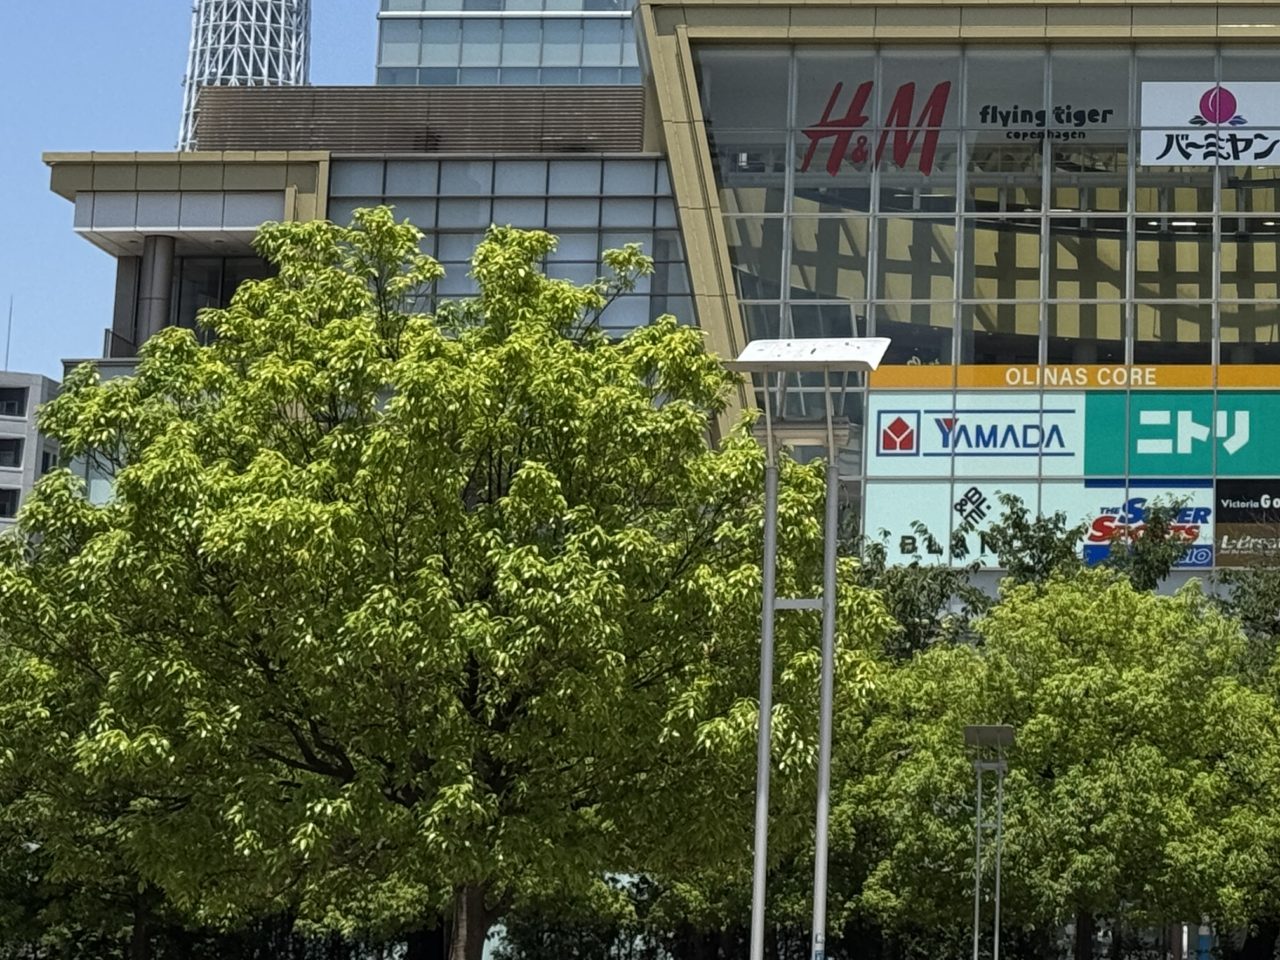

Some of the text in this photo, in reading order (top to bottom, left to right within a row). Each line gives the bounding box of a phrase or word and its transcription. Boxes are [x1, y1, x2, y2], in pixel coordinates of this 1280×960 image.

[801, 80, 951, 177] H&M
[979, 104, 1113, 127] flying tiger
[1006, 129, 1086, 141] copenhagen
[1155, 132, 1280, 161] バーミヤン
[1005, 367, 1157, 386] OLINAS CORE
[934, 417, 1066, 448] YAMADA
[1136, 410, 1250, 455] ニトリ
[1220, 499, 1260, 508] Victoria
